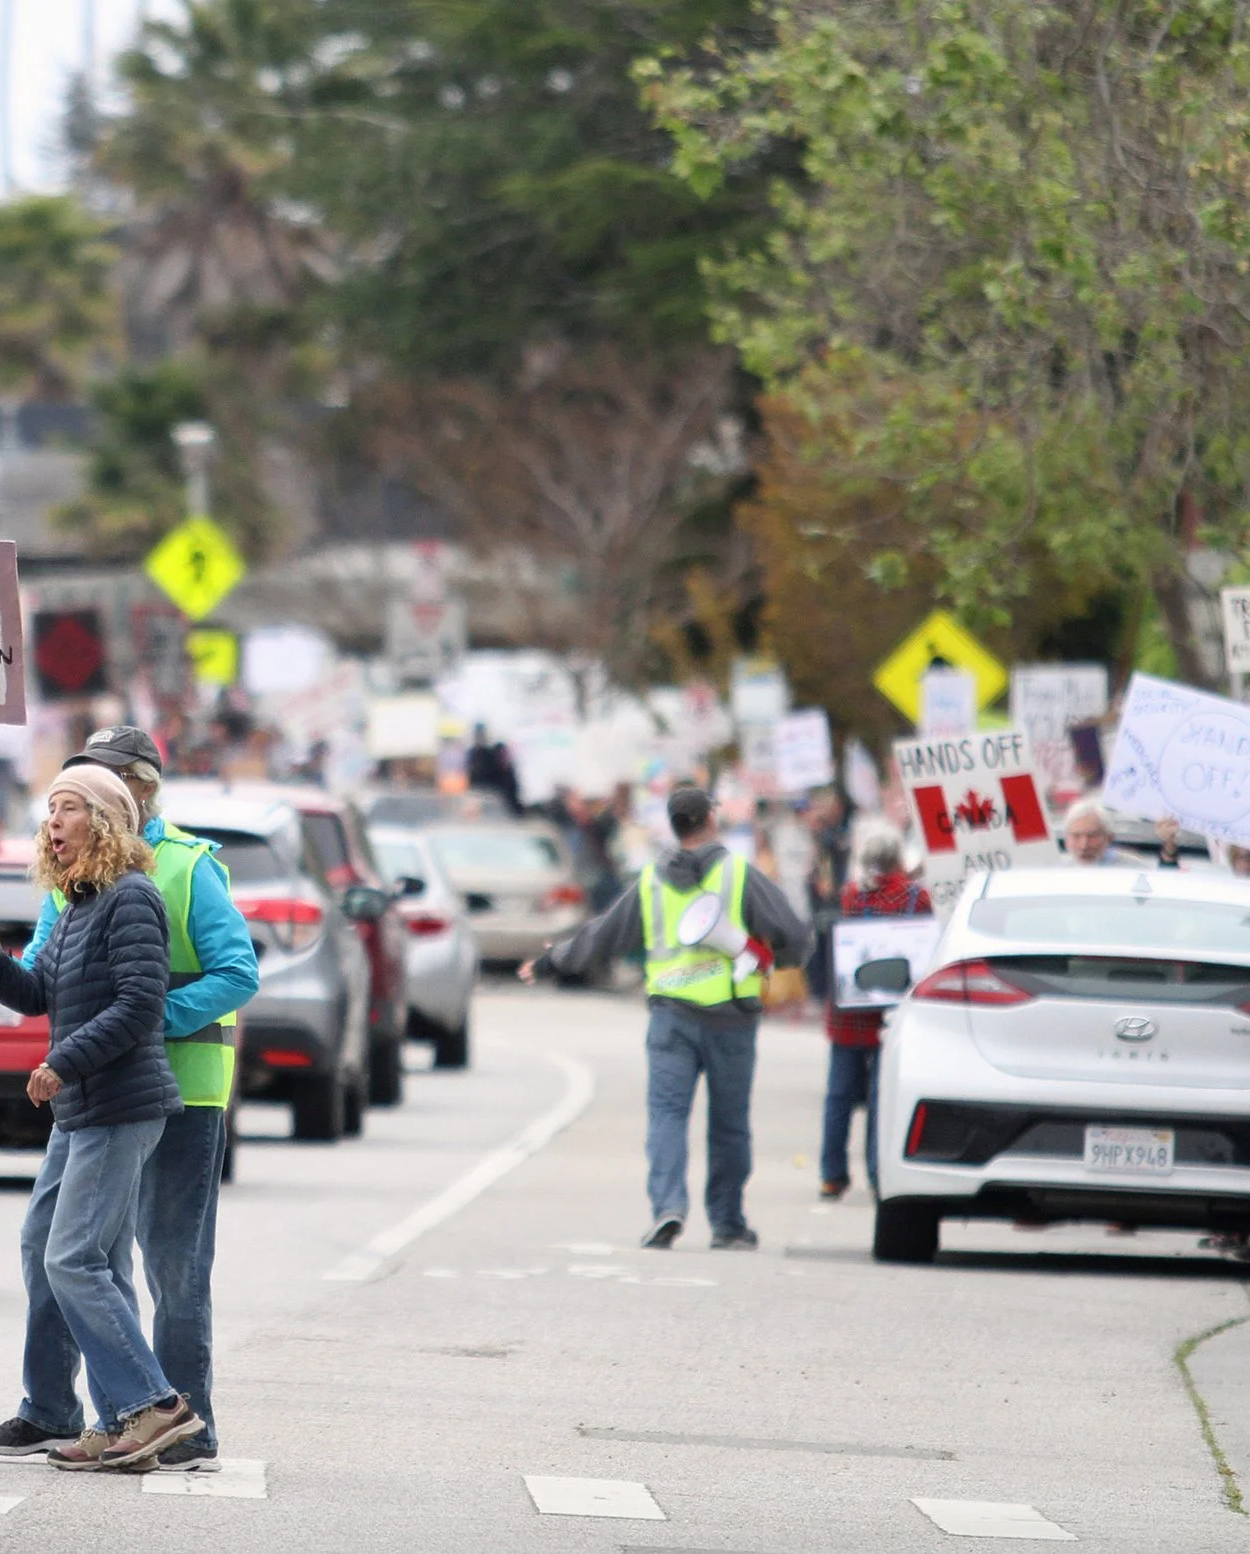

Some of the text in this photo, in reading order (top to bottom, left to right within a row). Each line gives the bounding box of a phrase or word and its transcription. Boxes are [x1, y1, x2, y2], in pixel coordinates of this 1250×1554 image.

[900, 739, 975, 777] HANDS
[982, 734, 1023, 769] OFF
[937, 803, 1019, 834] CANADA
[964, 850, 1012, 872] AND
